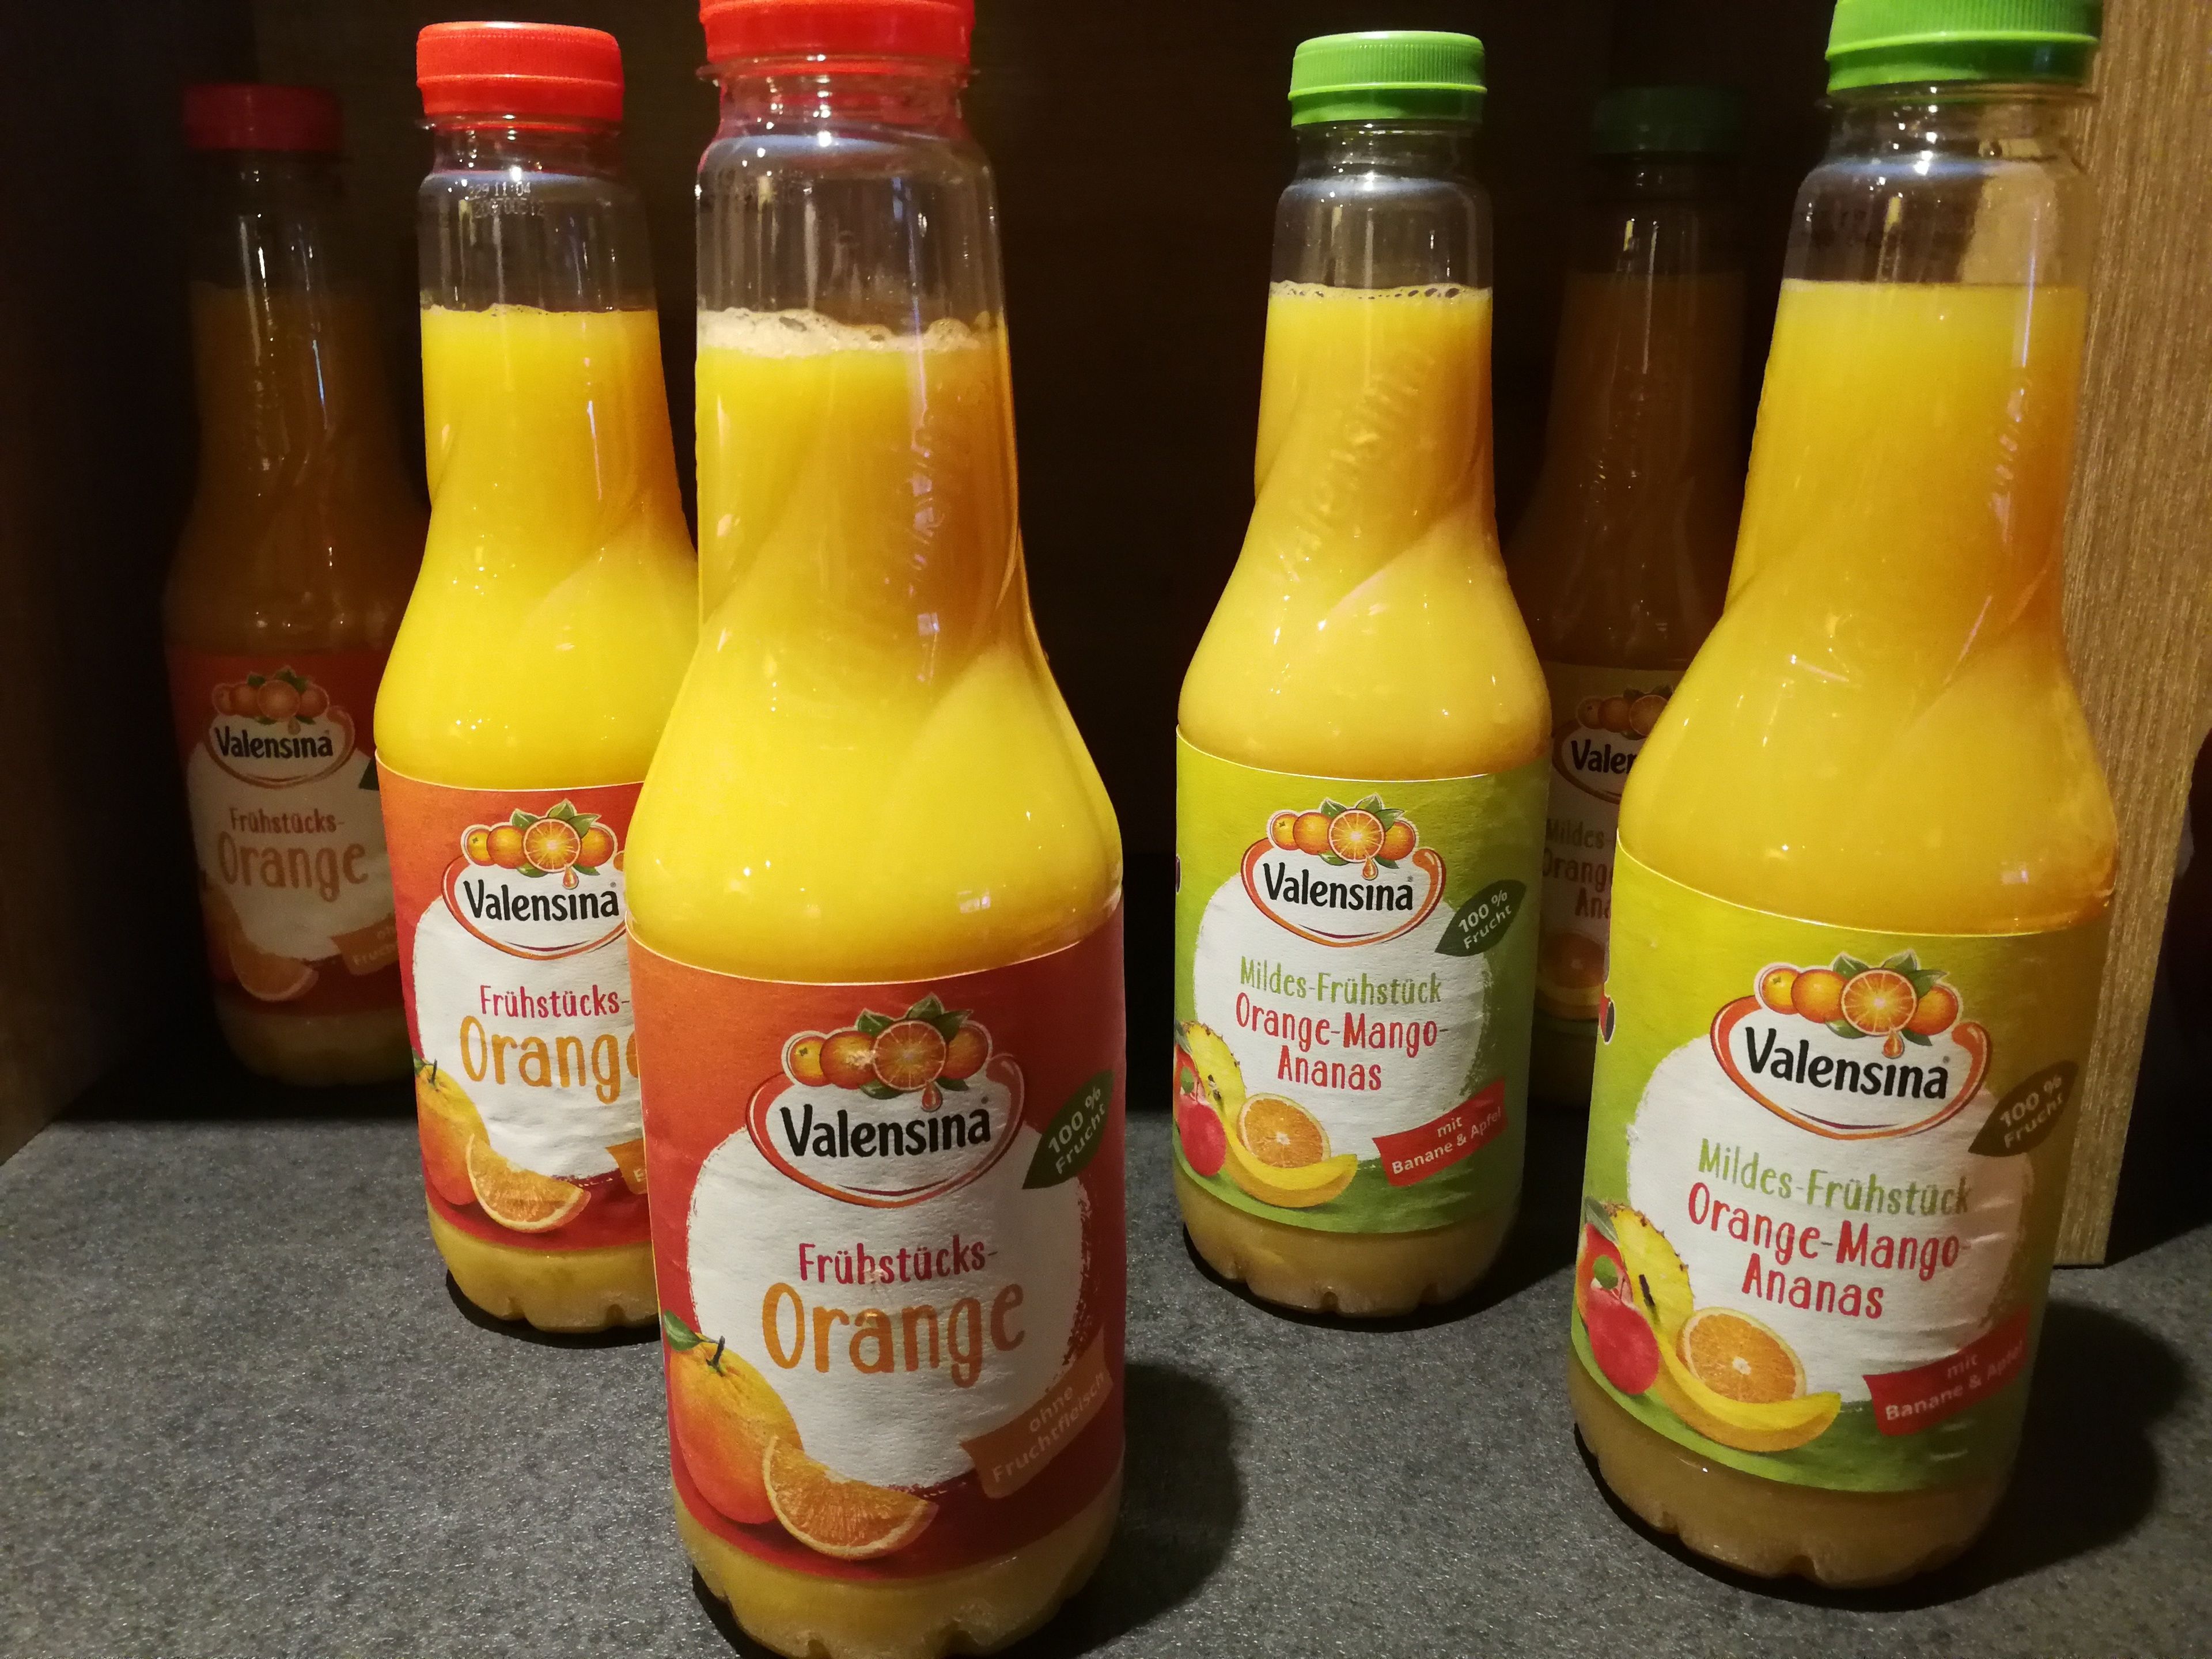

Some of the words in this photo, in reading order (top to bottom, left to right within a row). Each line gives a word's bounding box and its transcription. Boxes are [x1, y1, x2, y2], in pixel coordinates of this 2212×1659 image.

[215, 727, 332, 758] Valensina
[230, 808, 344, 834] Frühstücks-
[218, 832, 368, 902] Orange
[1263, 862, 1414, 911] Valensina
[464, 880, 619, 922] Valensina
[1458, 904, 1490, 934] 100
[1463, 905, 1512, 950] Frucht
[480, 984, 630, 1019] Frühstücks-
[1240, 956, 1441, 1005] Mildes-Frühstück
[1236, 992, 1449, 1058] Orange-Mango-
[1278, 1045, 1381, 1091] Ananas
[1745, 1027, 1948, 1100] Valensina
[781, 1103, 991, 1158] Valensina
[1048, 1111, 1084, 1153] 100
[1437, 1115, 1463, 1139] mit
[2000, 1092, 2039, 1127] 100
[2004, 1093, 2062, 1149] Frucht
[1056, 1103, 1105, 1175] Frucht
[1391, 1141, 1453, 1175] Banane
[1470, 1108, 1501, 1140] Apfel
[1698, 1138, 1970, 1217] Mildes-Frühstück
[1688, 1182, 1969, 1281] Orange-Mango-
[798, 1234, 998, 1285] Frühstücks-
[1741, 1253, 1884, 1320] Ananas
[762, 1282, 1025, 1388] Orange
[1029, 1386, 1074, 1433] ohne
[1885, 1384, 1964, 1421] Banane
